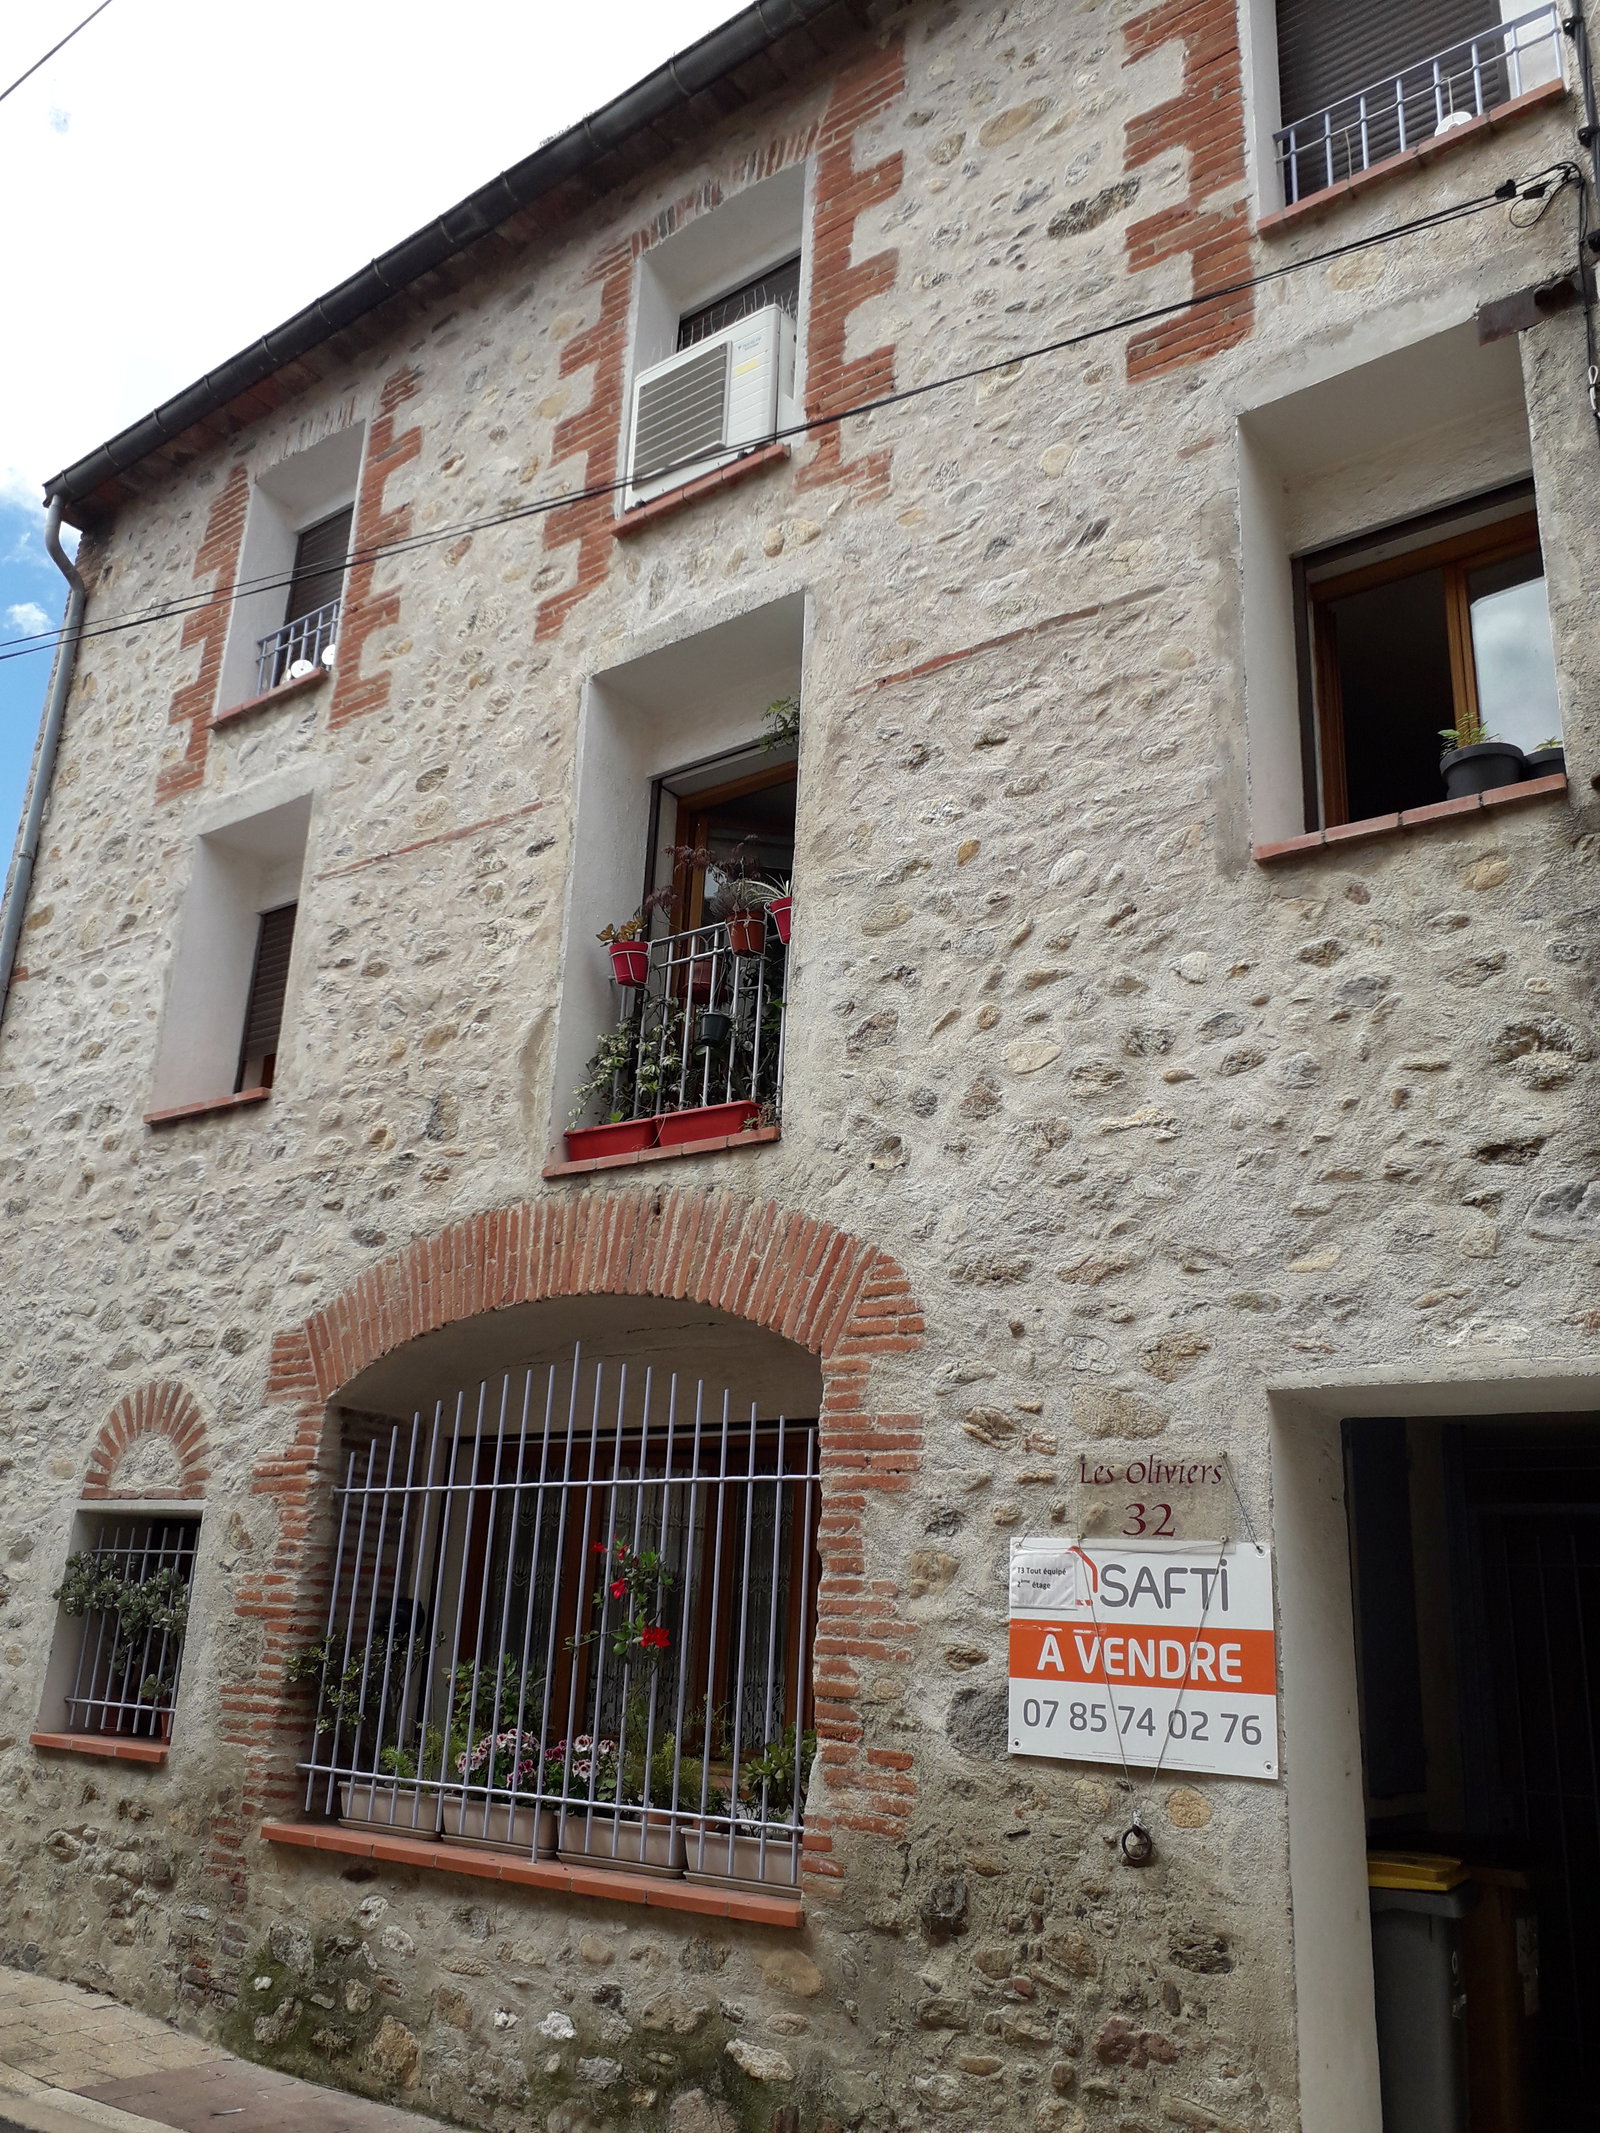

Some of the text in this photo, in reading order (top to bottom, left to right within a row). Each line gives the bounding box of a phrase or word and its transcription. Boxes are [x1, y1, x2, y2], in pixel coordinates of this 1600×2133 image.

[1079, 1455, 1223, 1486] Les Oliviers
[1122, 1503, 1176, 1537] 32
[1032, 1581, 1051, 1590] étage
[1043, 1568, 1066, 1576] équipé
[1073, 1634, 1243, 1683] VENDRE
[1023, 1698, 1262, 1746] 07 85 74 02 76
